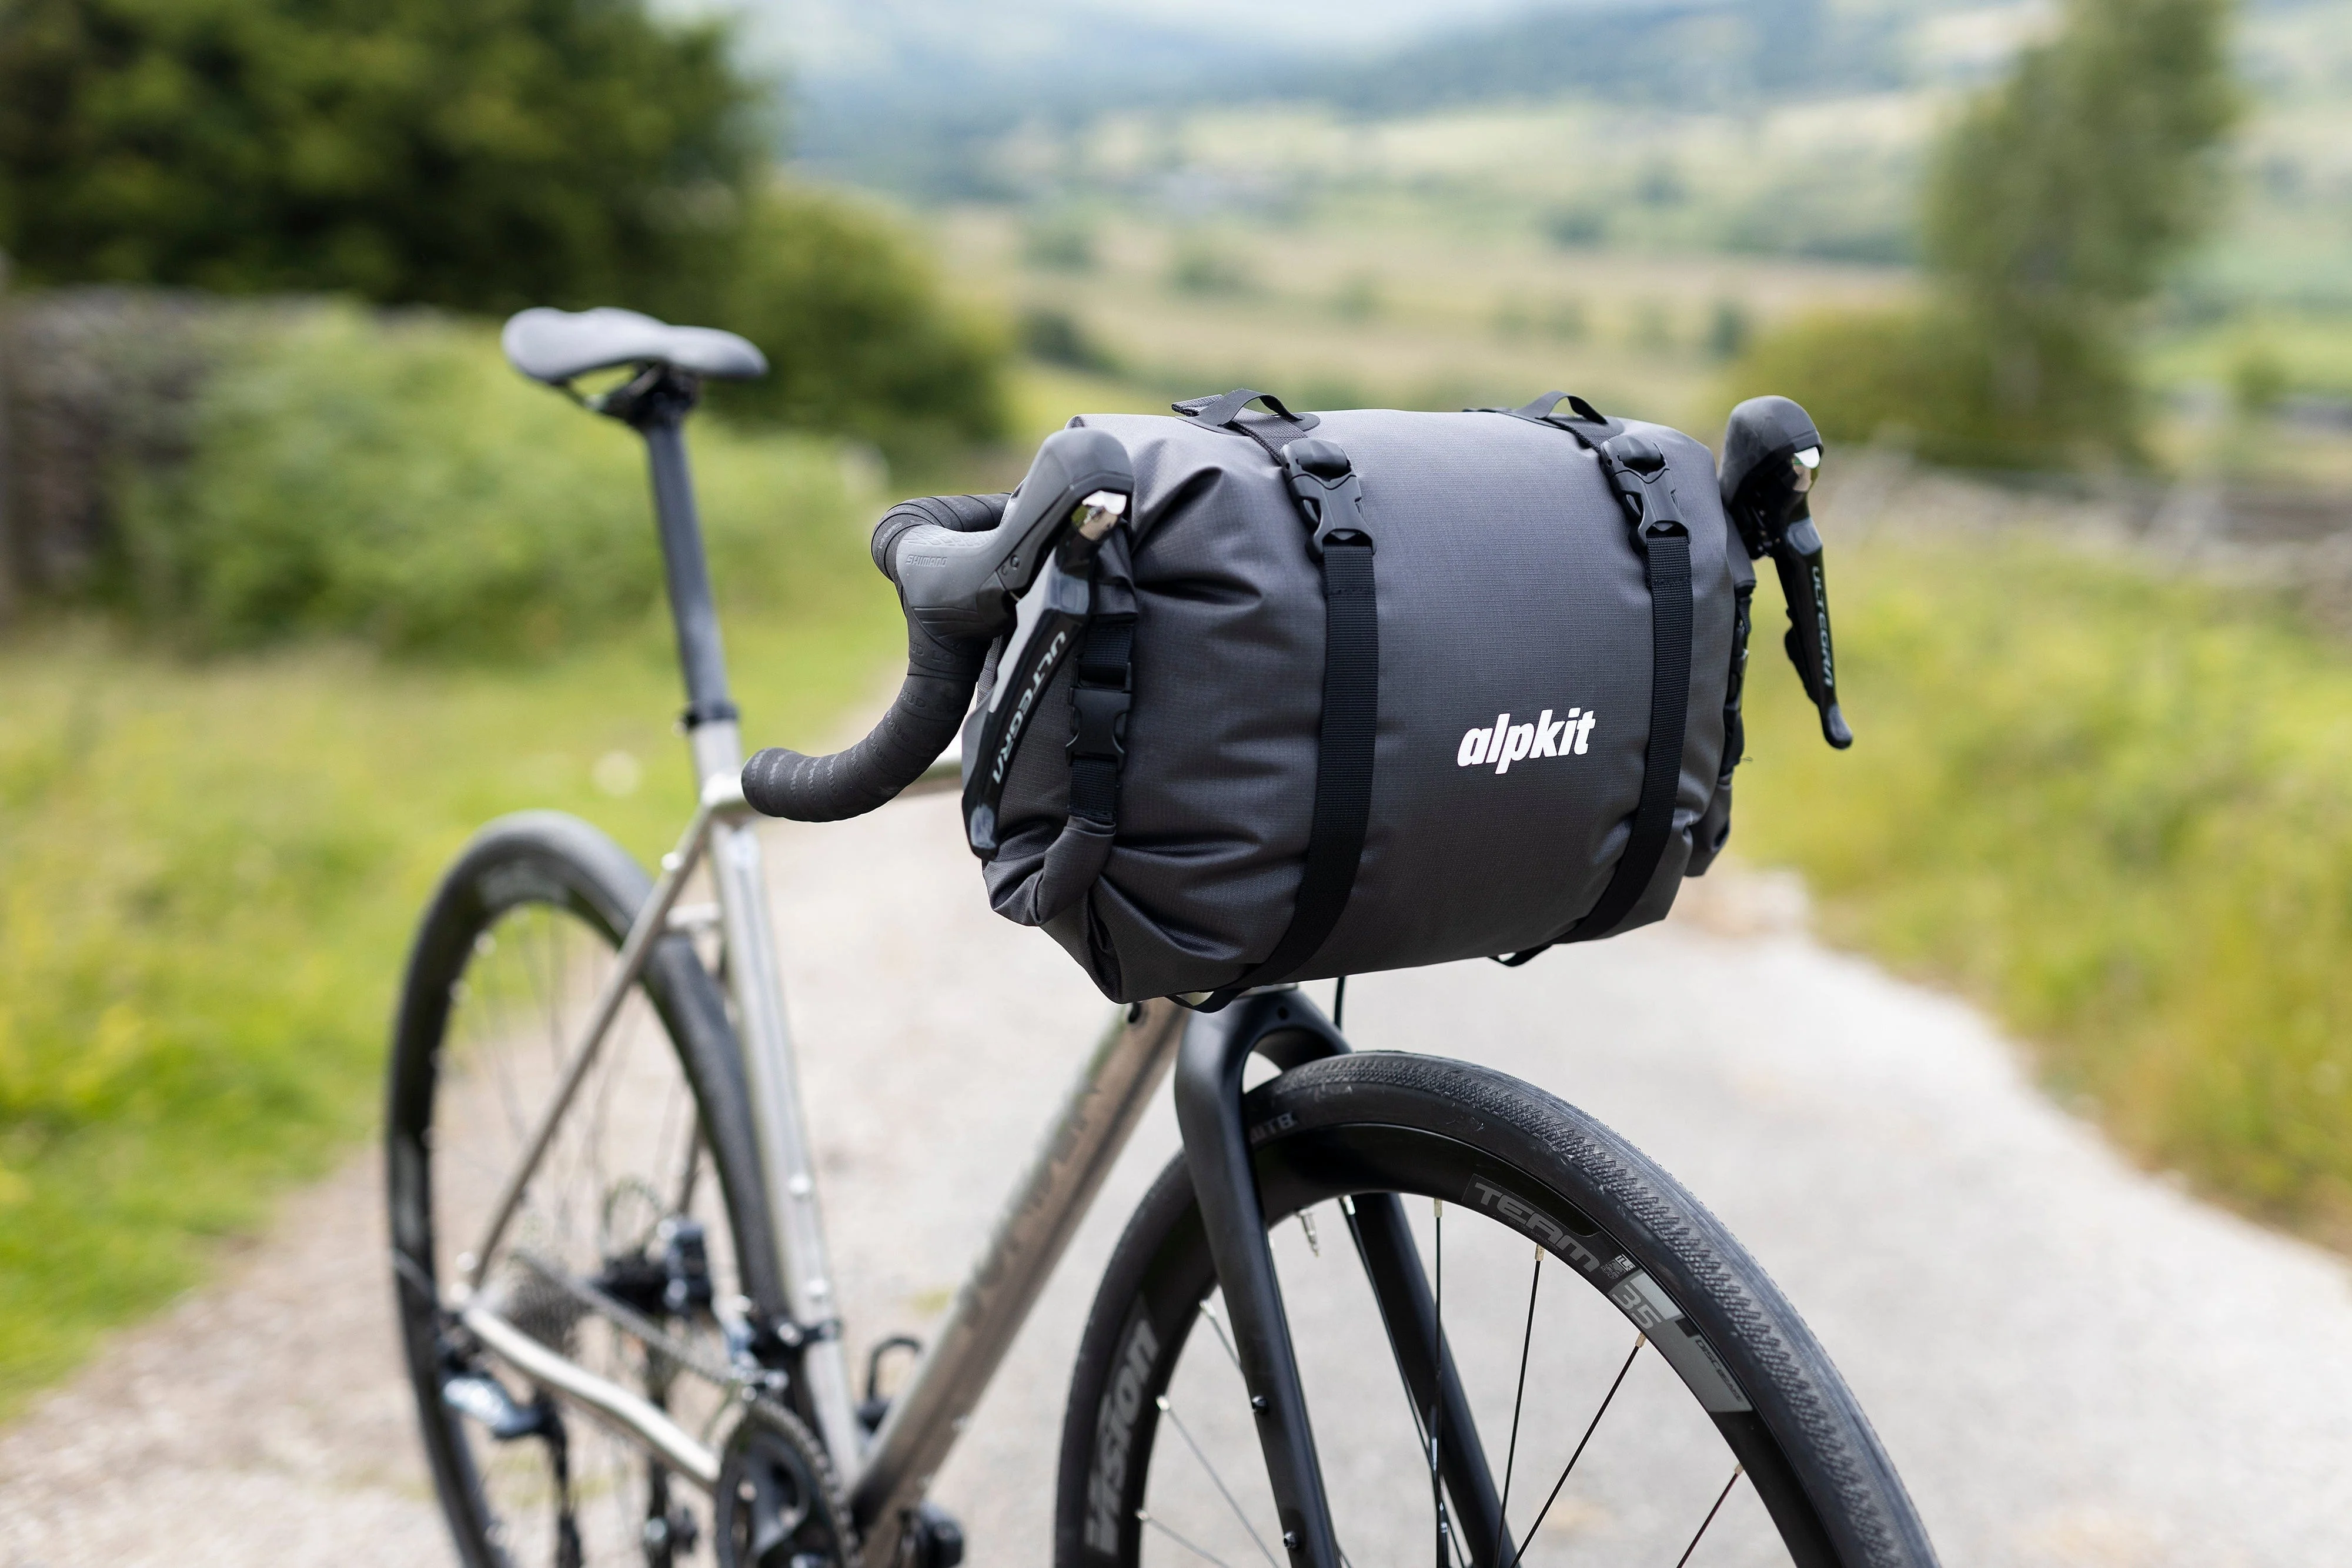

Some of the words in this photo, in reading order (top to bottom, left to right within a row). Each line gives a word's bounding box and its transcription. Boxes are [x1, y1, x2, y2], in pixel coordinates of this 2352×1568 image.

[906, 554, 948, 567] SHIMANO
[992, 630, 1066, 784] ULTEGRA
[1457, 707, 1596, 774] alpkit
[1475, 1182, 1601, 1273] TEAM
[1612, 1284, 1662, 1329] 35
[1695, 1339, 1721, 1368] DISC
